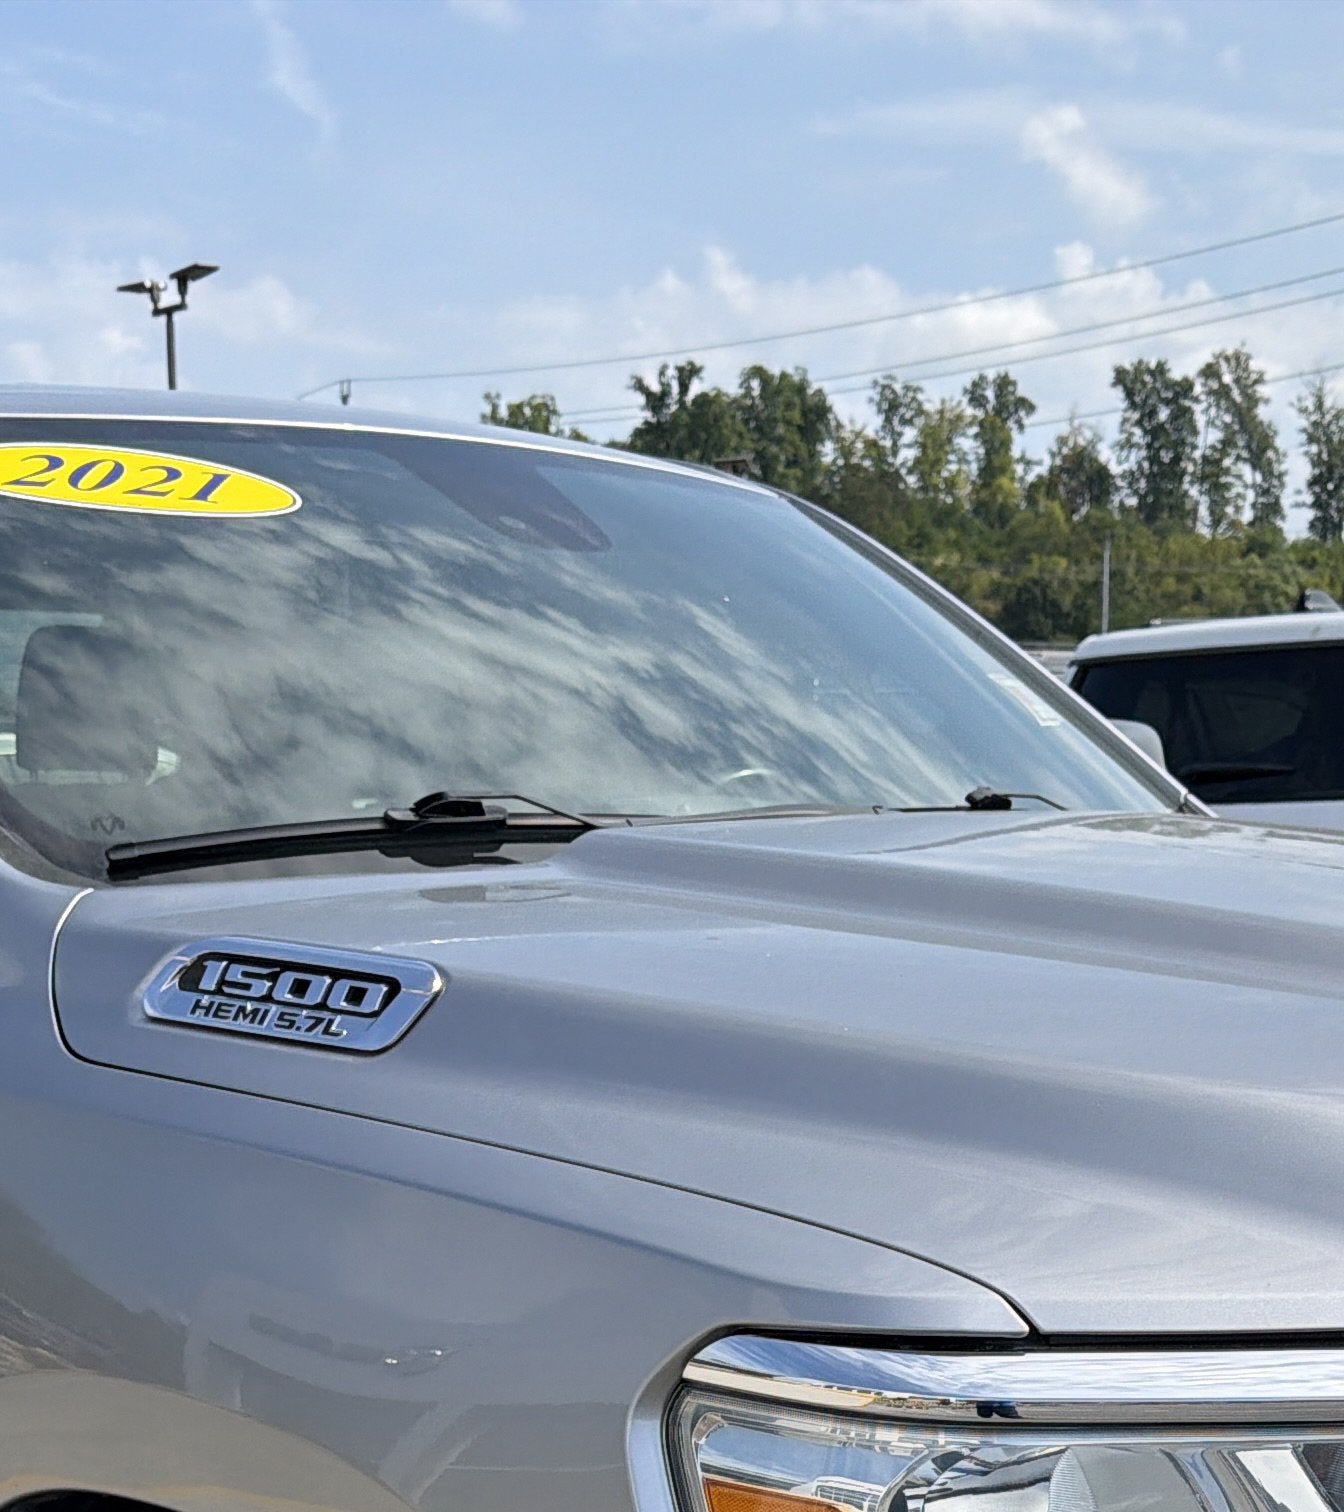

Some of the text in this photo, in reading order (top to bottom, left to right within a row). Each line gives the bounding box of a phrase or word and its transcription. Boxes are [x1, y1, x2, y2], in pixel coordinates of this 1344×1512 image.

[2, 454, 232, 504] 2021
[198, 959, 391, 1012] 1500
[190, 998, 348, 1038] HEMI 5.7L
